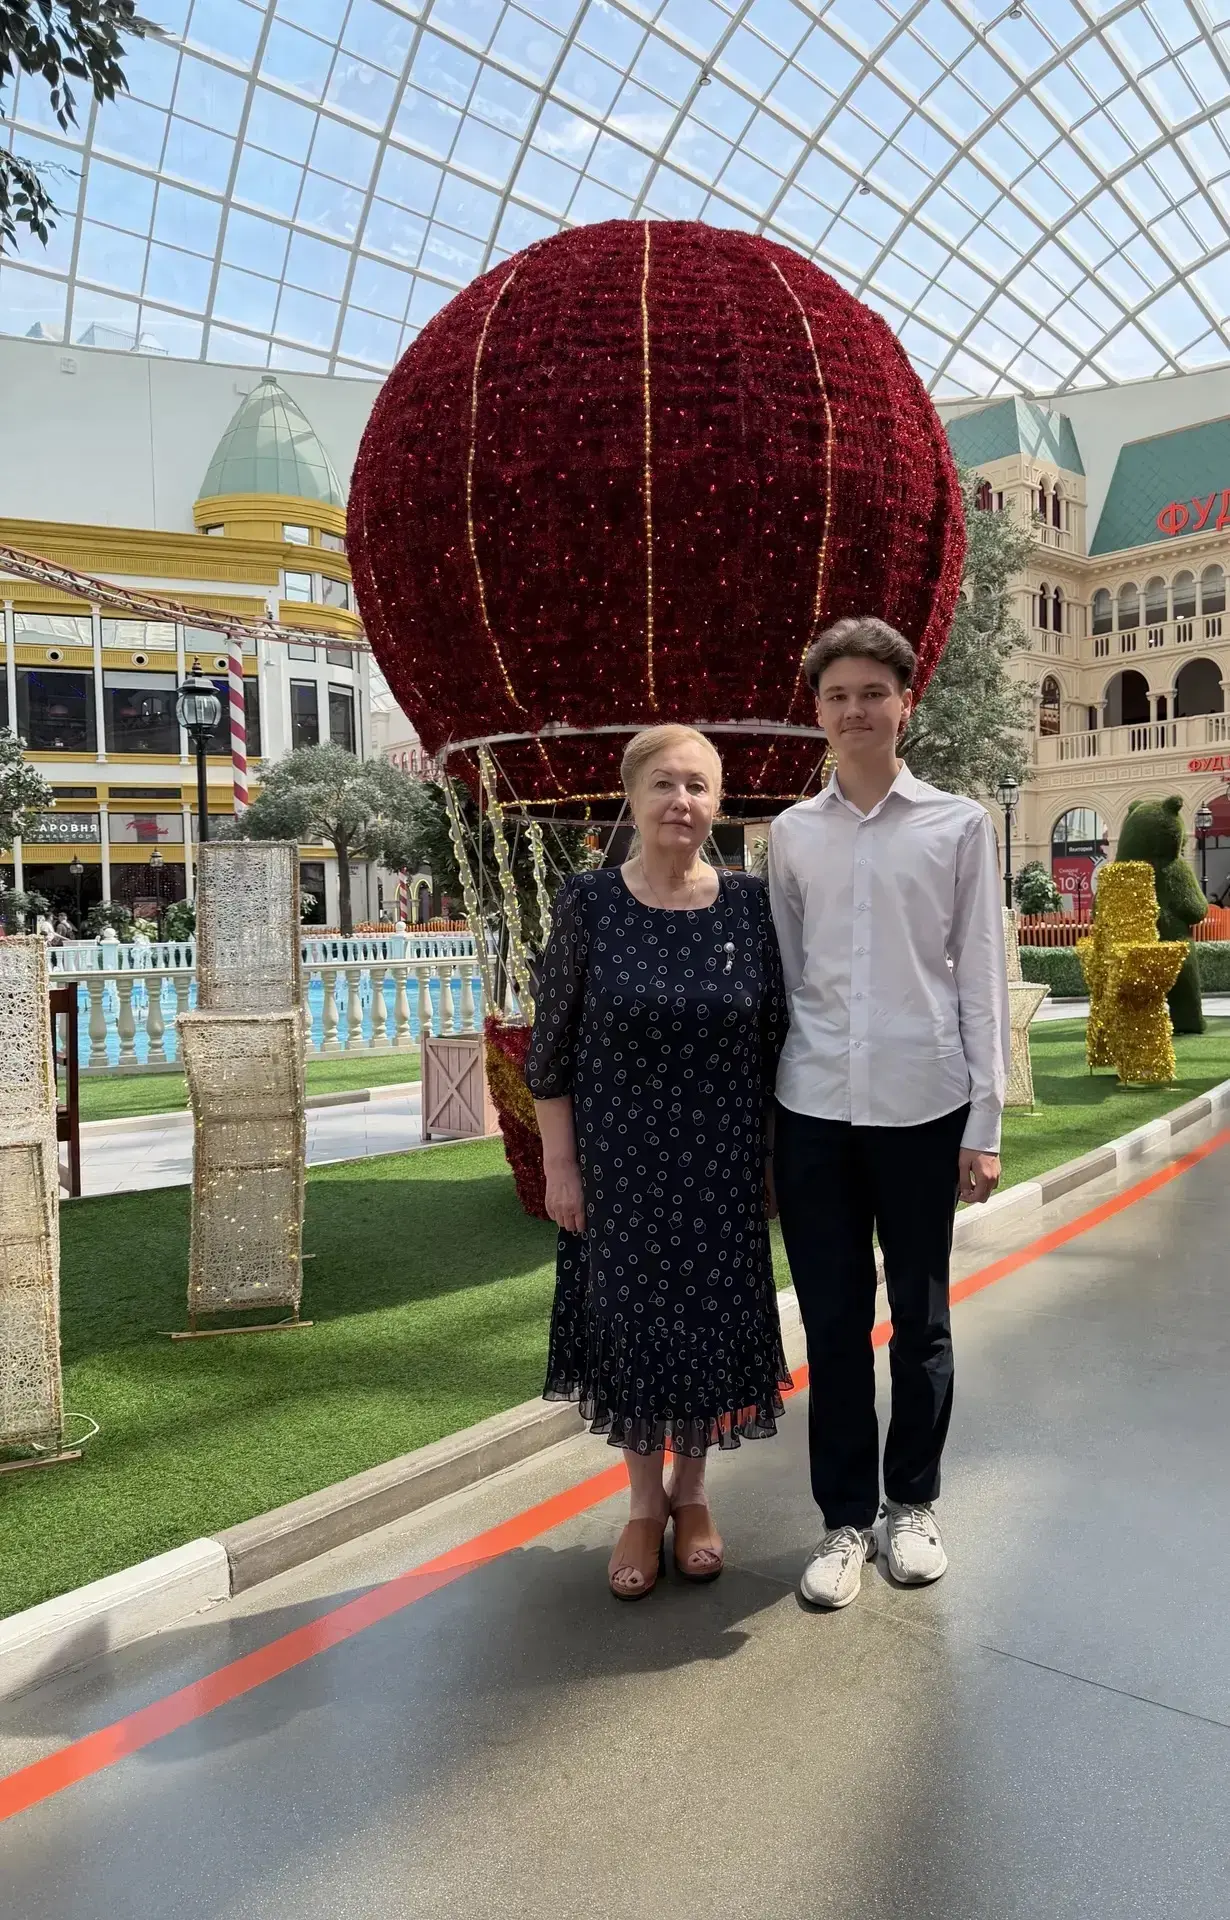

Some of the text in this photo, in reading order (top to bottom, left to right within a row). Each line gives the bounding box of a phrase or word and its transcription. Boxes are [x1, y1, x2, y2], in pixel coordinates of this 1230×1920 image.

[1188, 755, 1224, 772] ФУД
[39, 823, 98, 833] АРОВНЯ
[1058, 876, 1089, 891] 10%
